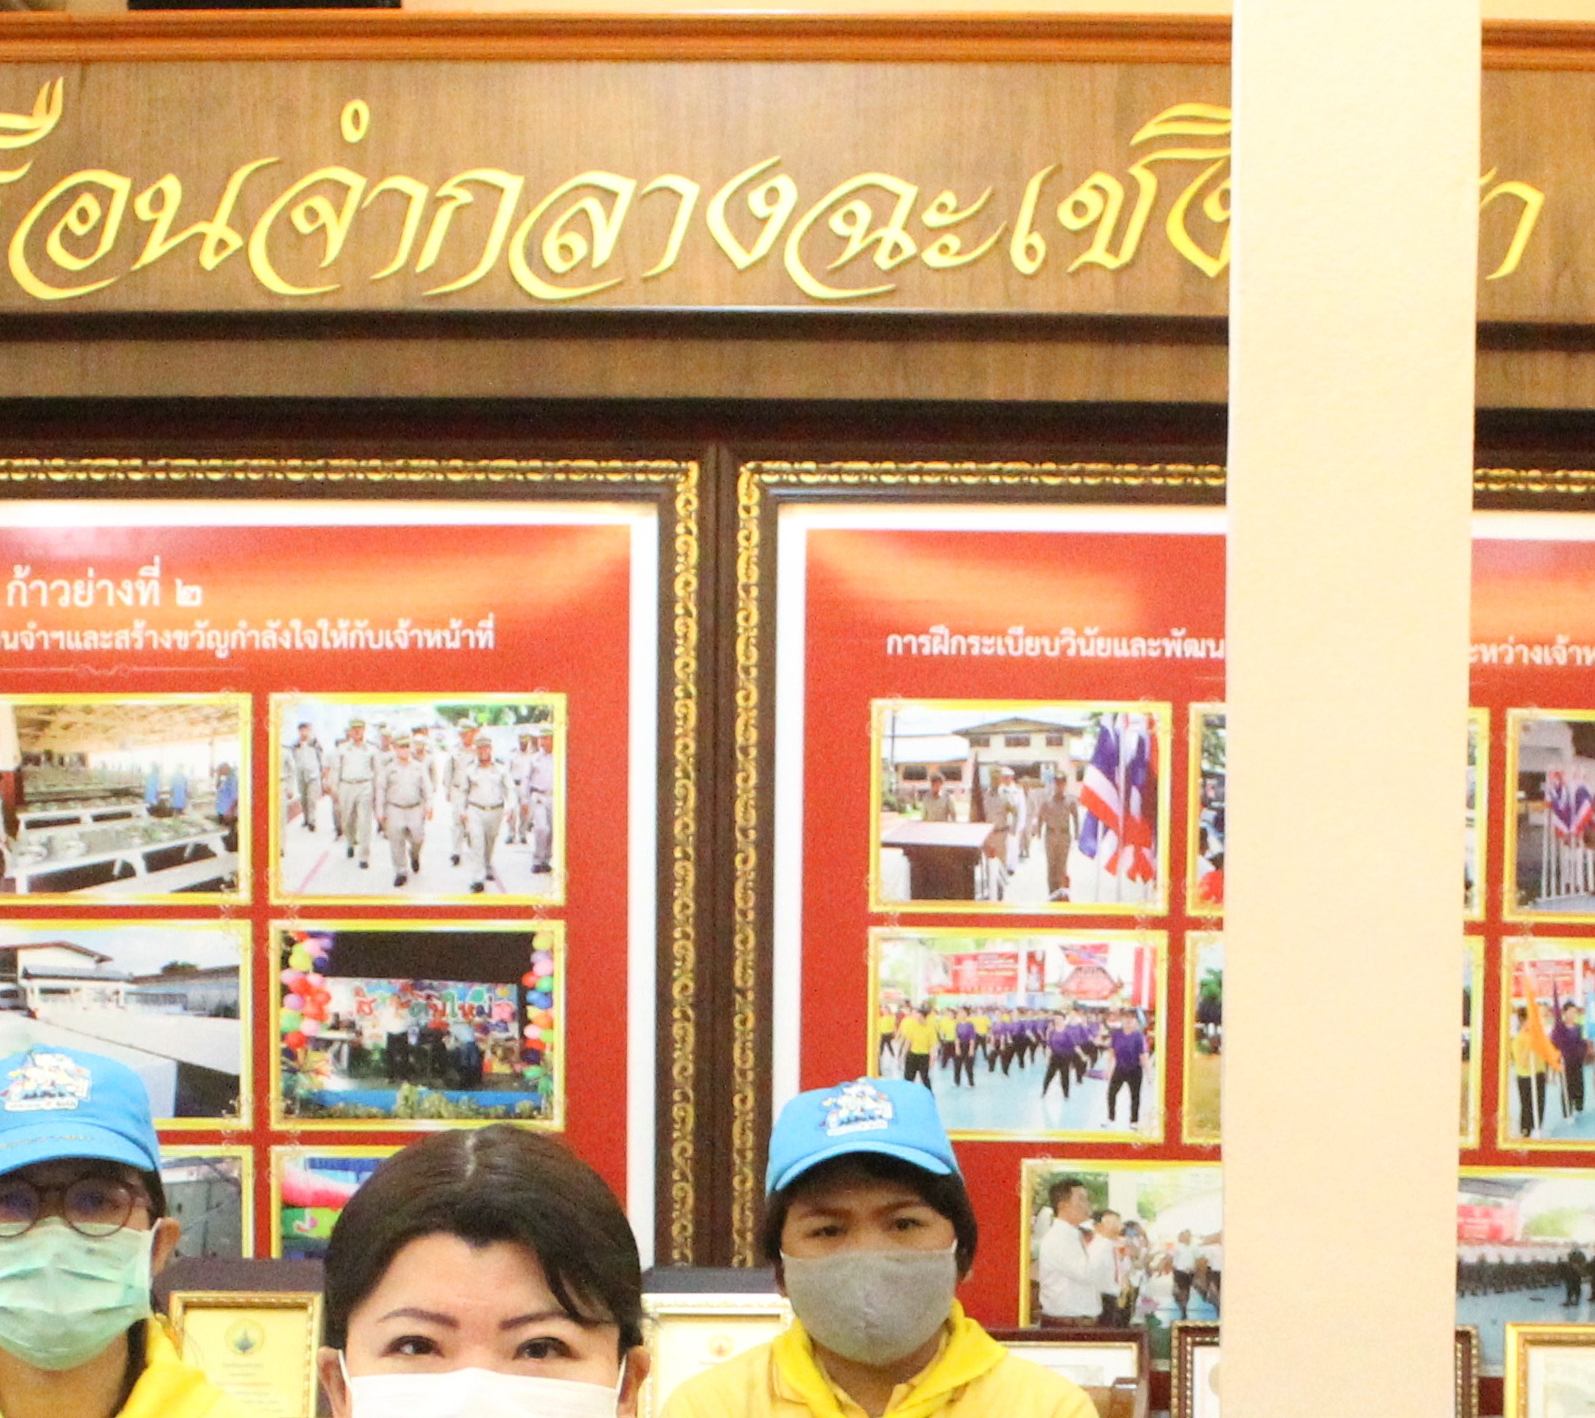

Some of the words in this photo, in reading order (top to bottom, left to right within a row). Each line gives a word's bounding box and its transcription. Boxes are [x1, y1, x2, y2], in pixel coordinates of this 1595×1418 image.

[6, 554, 162, 608] ก้าวย่างที่
[174, 578, 204, 608] ๒
